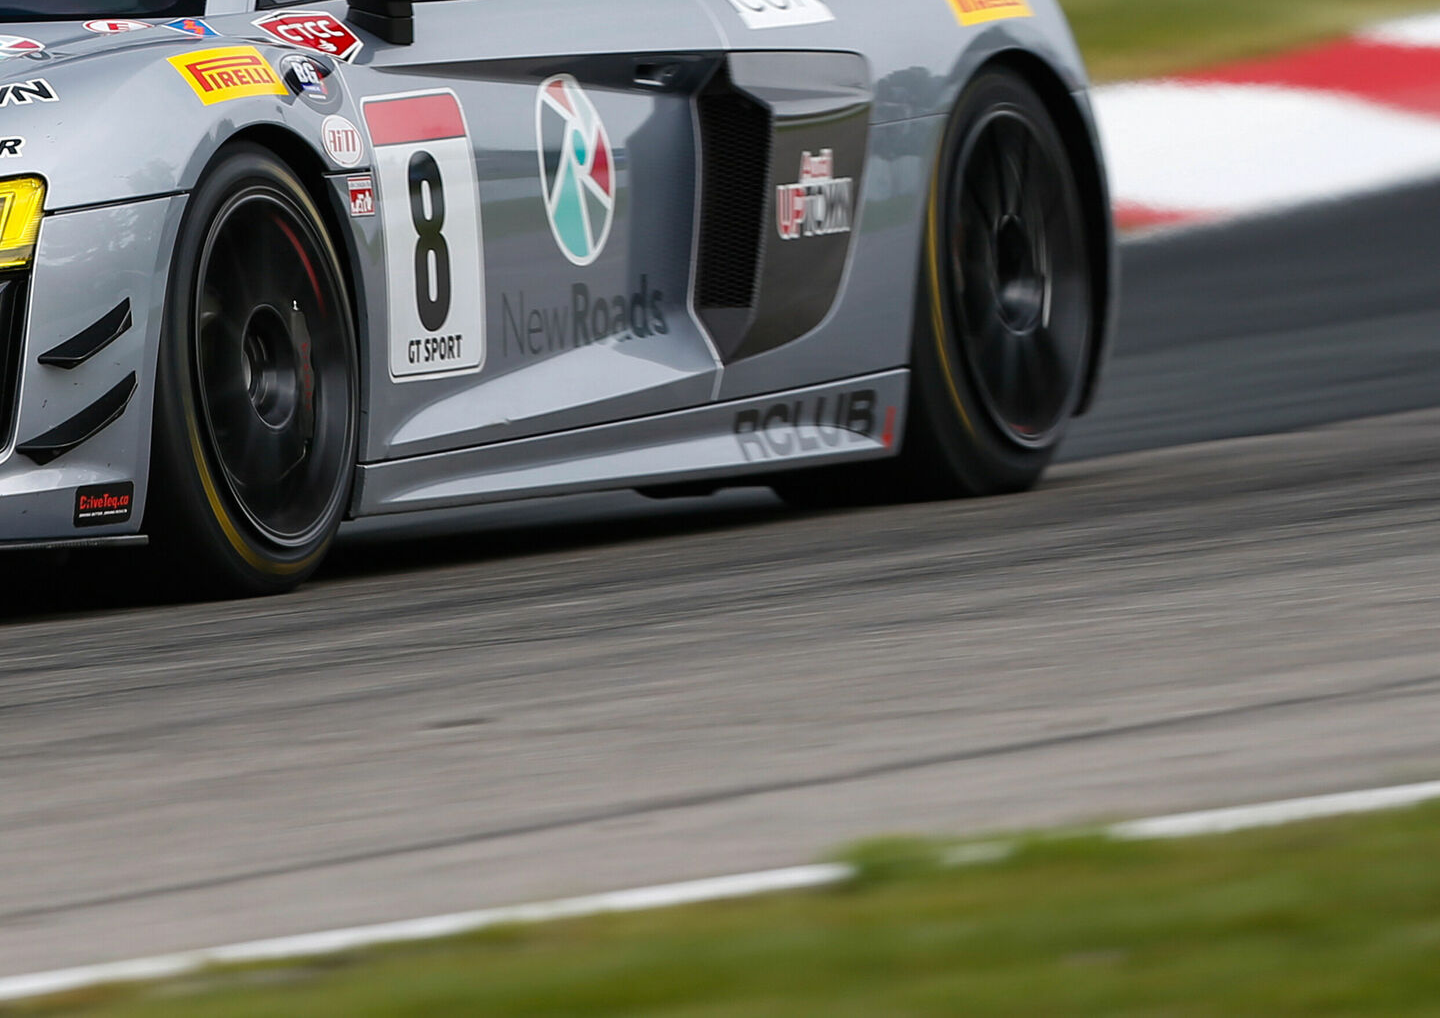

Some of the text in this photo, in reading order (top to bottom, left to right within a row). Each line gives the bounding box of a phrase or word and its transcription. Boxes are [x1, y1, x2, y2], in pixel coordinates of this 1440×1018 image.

[276, 19, 345, 41] CTCC
[185, 55, 275, 92] PIRELLI
[291, 61, 320, 84] BG
[408, 150, 452, 332] 8
[408, 335, 462, 364] GT SPORT
